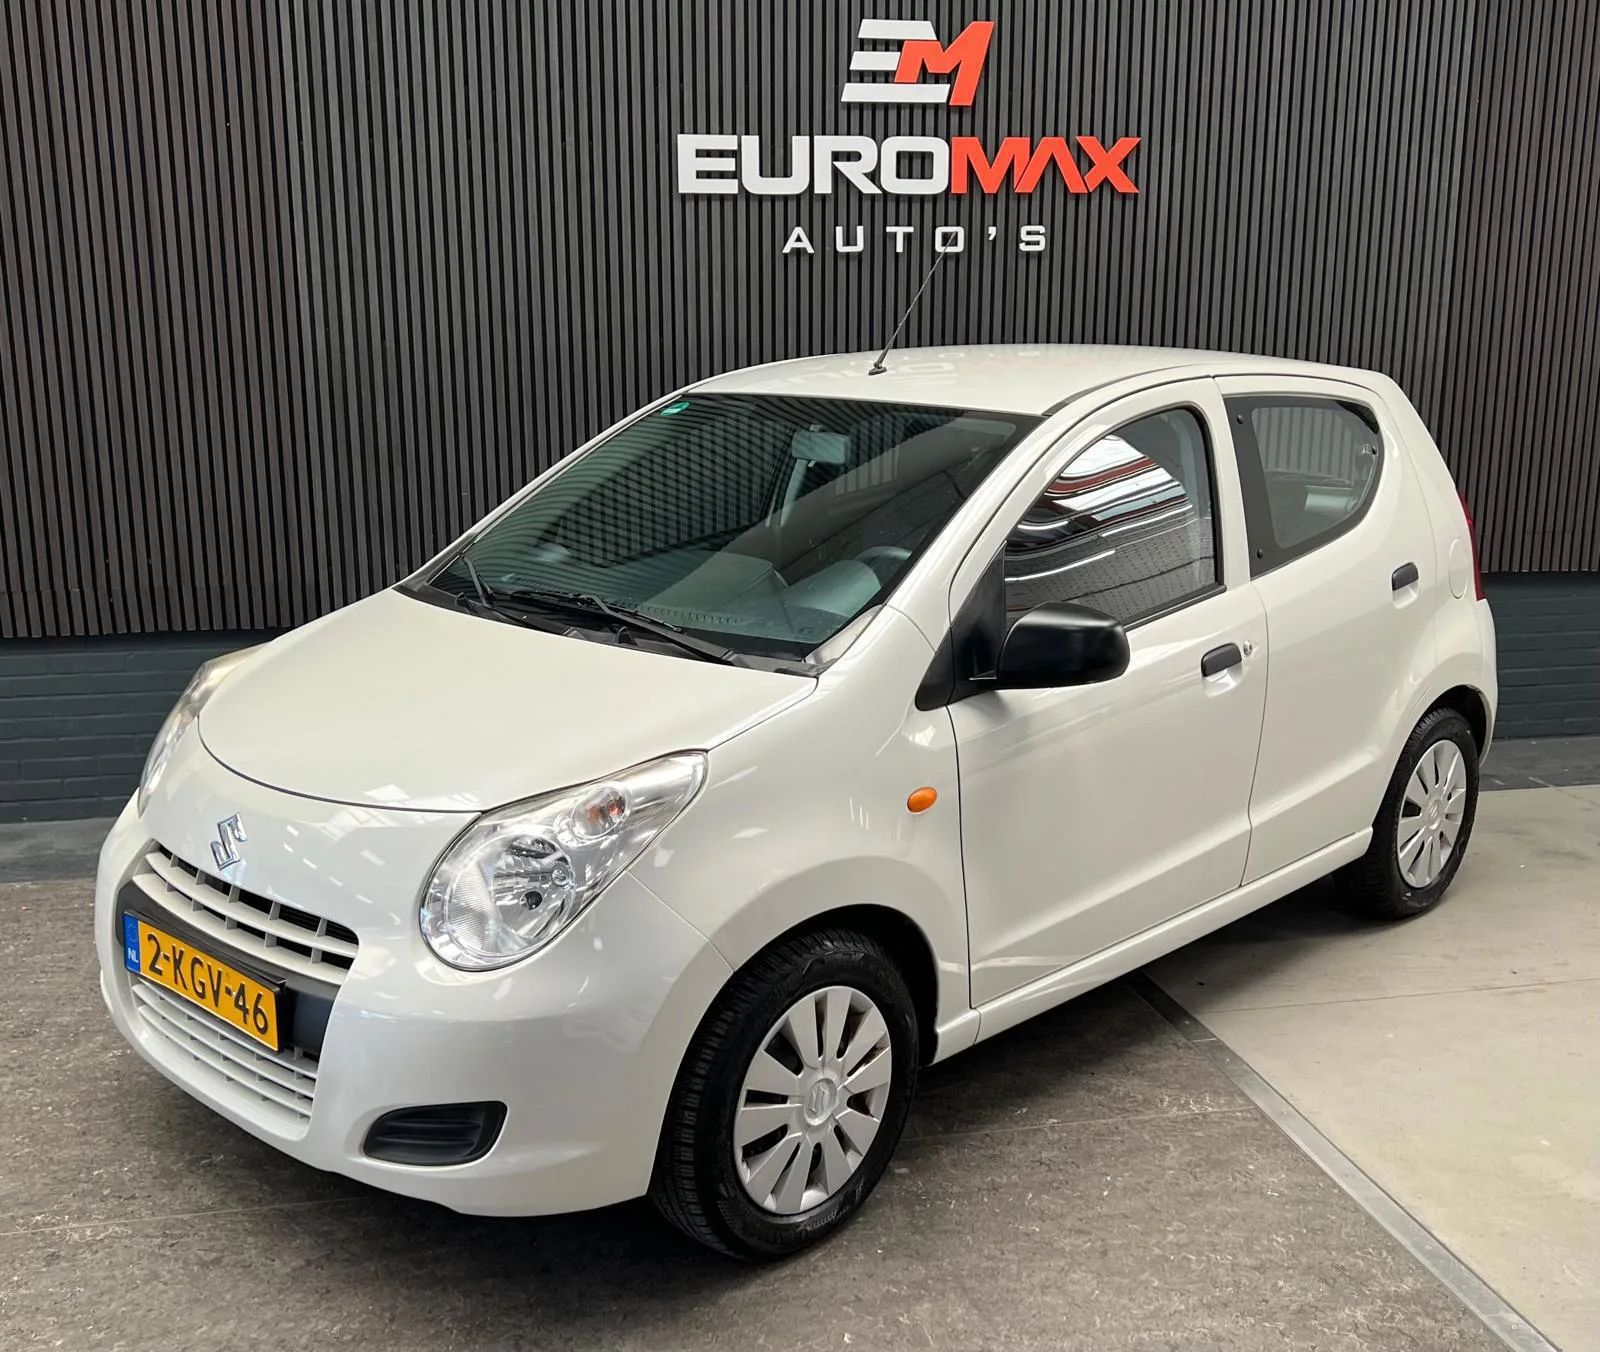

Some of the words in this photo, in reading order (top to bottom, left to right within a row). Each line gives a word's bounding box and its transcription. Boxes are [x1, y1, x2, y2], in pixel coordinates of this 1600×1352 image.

[677, 134, 1141, 194] EUROMAX
[783, 225, 1046, 253] AUTO'S
[128, 947, 139, 963] NL
[147, 933, 268, 1035] 2-KGV-46
